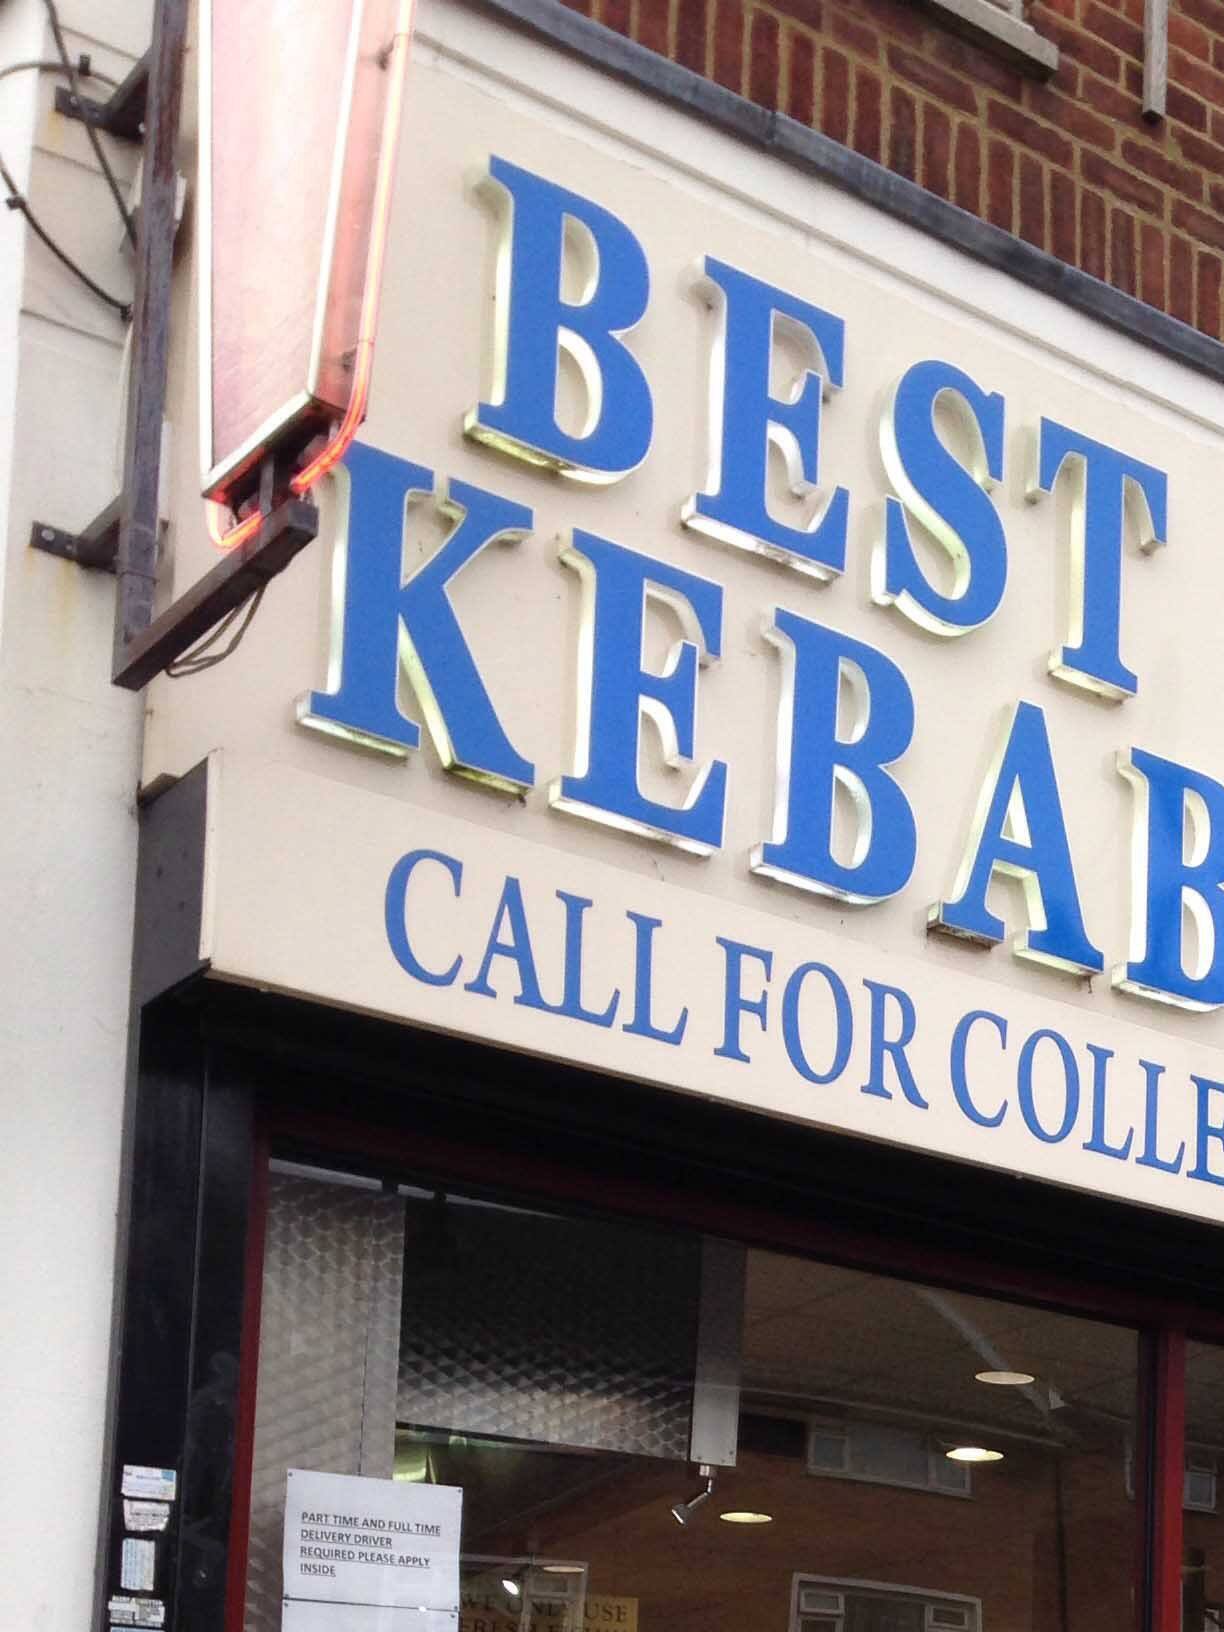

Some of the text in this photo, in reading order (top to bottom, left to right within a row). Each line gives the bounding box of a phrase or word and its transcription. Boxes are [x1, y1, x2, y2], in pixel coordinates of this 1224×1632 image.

[466, 154, 1167, 702] BEST
[384, 848, 688, 1045] CALL
[716, 937, 928, 1109] FOR
[301, 1512, 441, 1535] PART TIME AND FULL TIME
[301, 1529, 392, 1547] DELIVERY DRIVER
[300, 1546, 431, 1567] REQUIRED PLEASE APPLY
[300, 1563, 336, 1576] INSIDE
[584, 1602, 628, 1624] USE
